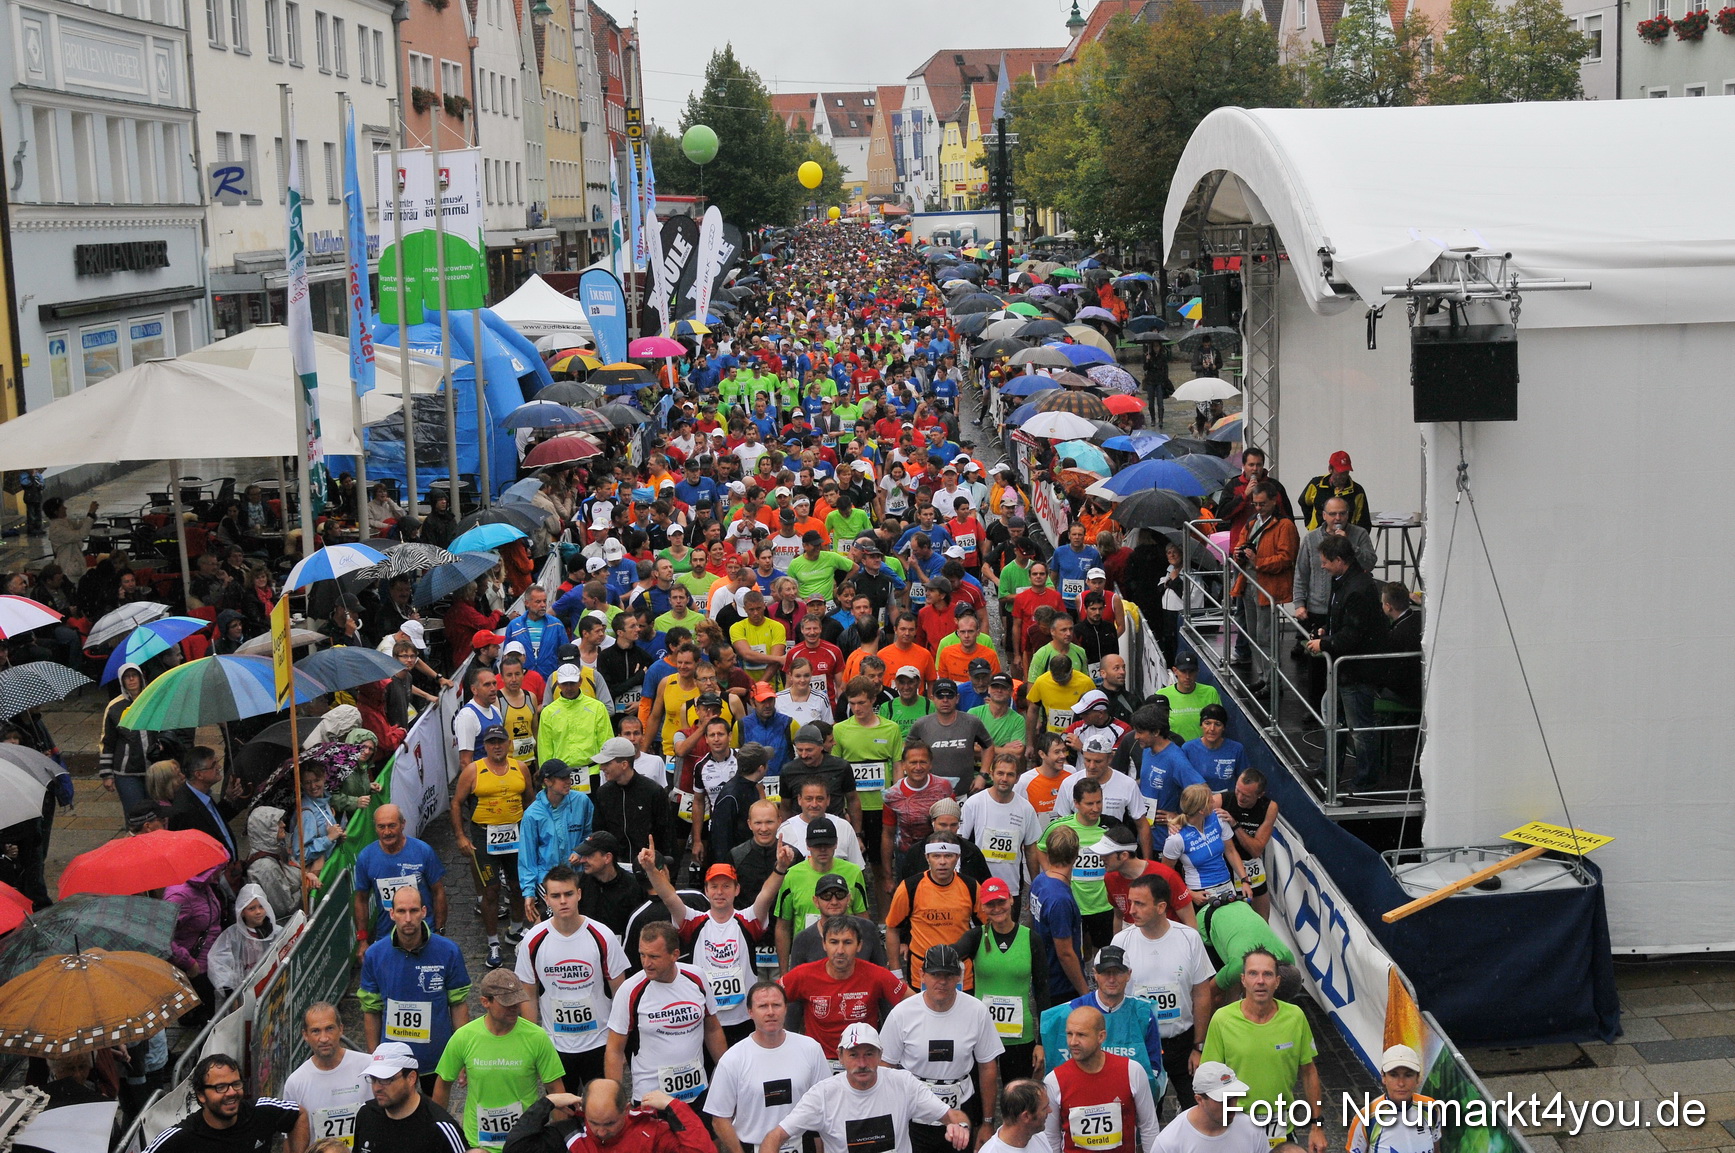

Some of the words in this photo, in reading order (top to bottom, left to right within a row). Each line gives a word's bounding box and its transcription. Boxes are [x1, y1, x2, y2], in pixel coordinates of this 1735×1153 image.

[64, 41, 106, 74] BRILLEN
[106, 49, 141, 80] WEBER
[627, 109, 643, 188] HOTE
[83, 242, 128, 275] BRILLEN
[128, 239, 170, 271] WEBER
[523, 323, 581, 331] www.audibkk.de
[957, 538, 976, 547] 2129
[1064, 584, 1083, 593] 2593
[855, 767, 882, 780] 2211
[490, 831, 517, 844] 2224
[1529, 824, 1602, 845] Treffpunkt
[989, 838, 1012, 851] 298
[1513, 831, 1588, 853] Kinderlauf
[1082, 869, 1099, 877] Bernd
[927, 912, 953, 921] OEXL
[544, 966, 583, 974] GERHART
[561, 971, 590, 979] JANIG
[710, 979, 741, 995] 290
[555, 1007, 592, 1023] 3166
[648, 1006, 692, 1019] GERHART
[670, 1012, 700, 1024] JANIG
[394, 1012, 422, 1028] 189
[393, 1029, 421, 1038] Karlheinz
[561, 1024, 590, 1032] Alexander
[664, 1070, 701, 1093] 3090
[676, 1091, 694, 1100] Georg
[324, 1117, 355, 1137] 277
[481, 1113, 518, 1132] 3165
[1080, 1116, 1113, 1135] 275
[1086, 1136, 1110, 1145] Gerald
